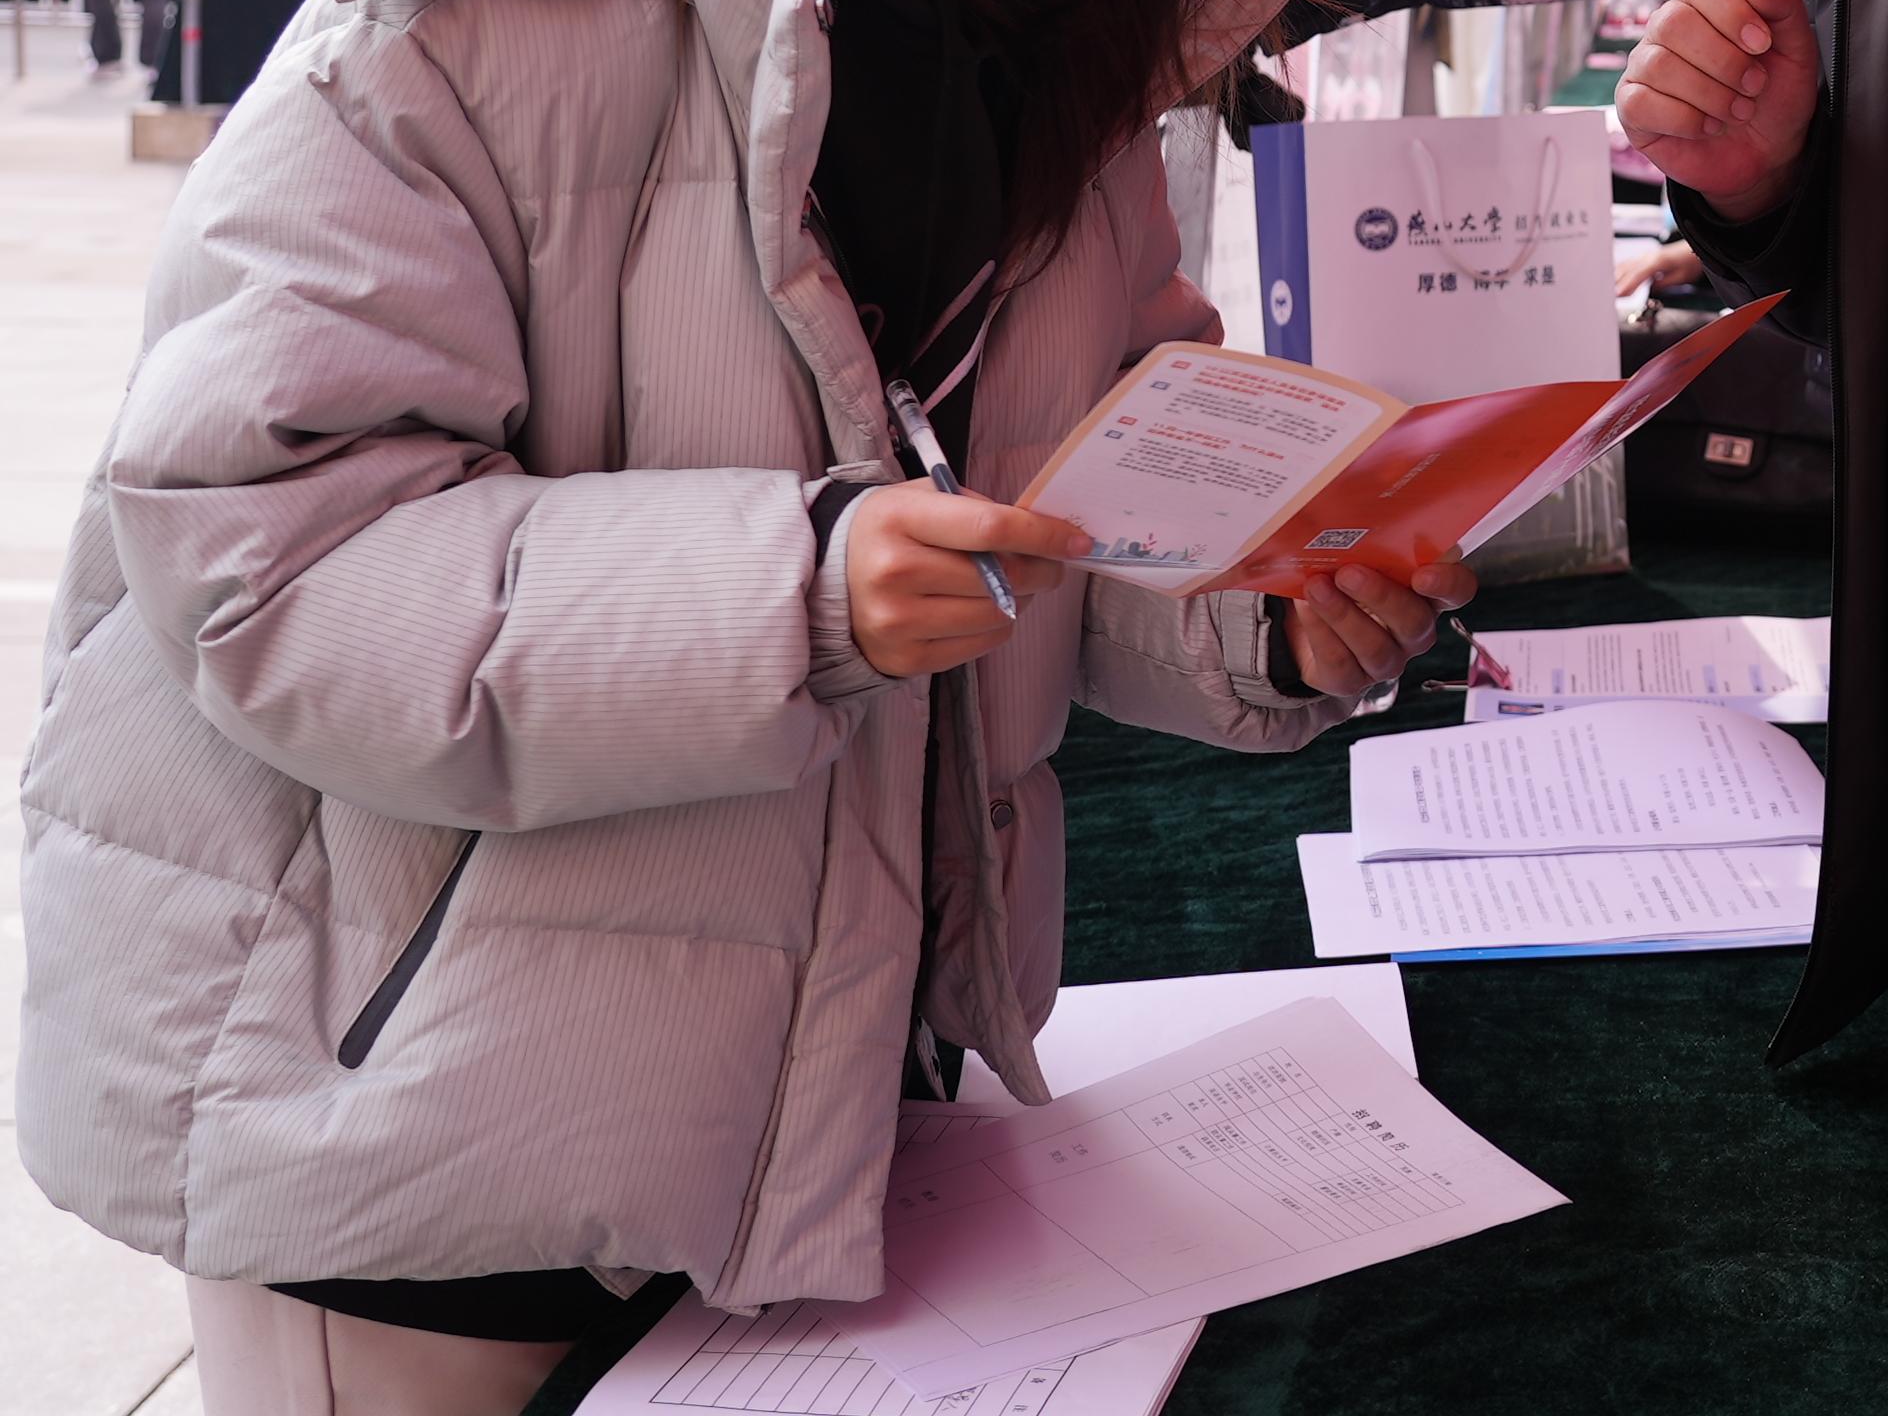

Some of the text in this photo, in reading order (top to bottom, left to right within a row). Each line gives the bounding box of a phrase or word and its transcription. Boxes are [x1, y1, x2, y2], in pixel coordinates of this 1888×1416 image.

[1417, 272, 1458, 293] 厚德
[1352, 1109, 1410, 1151] 招聘简历
